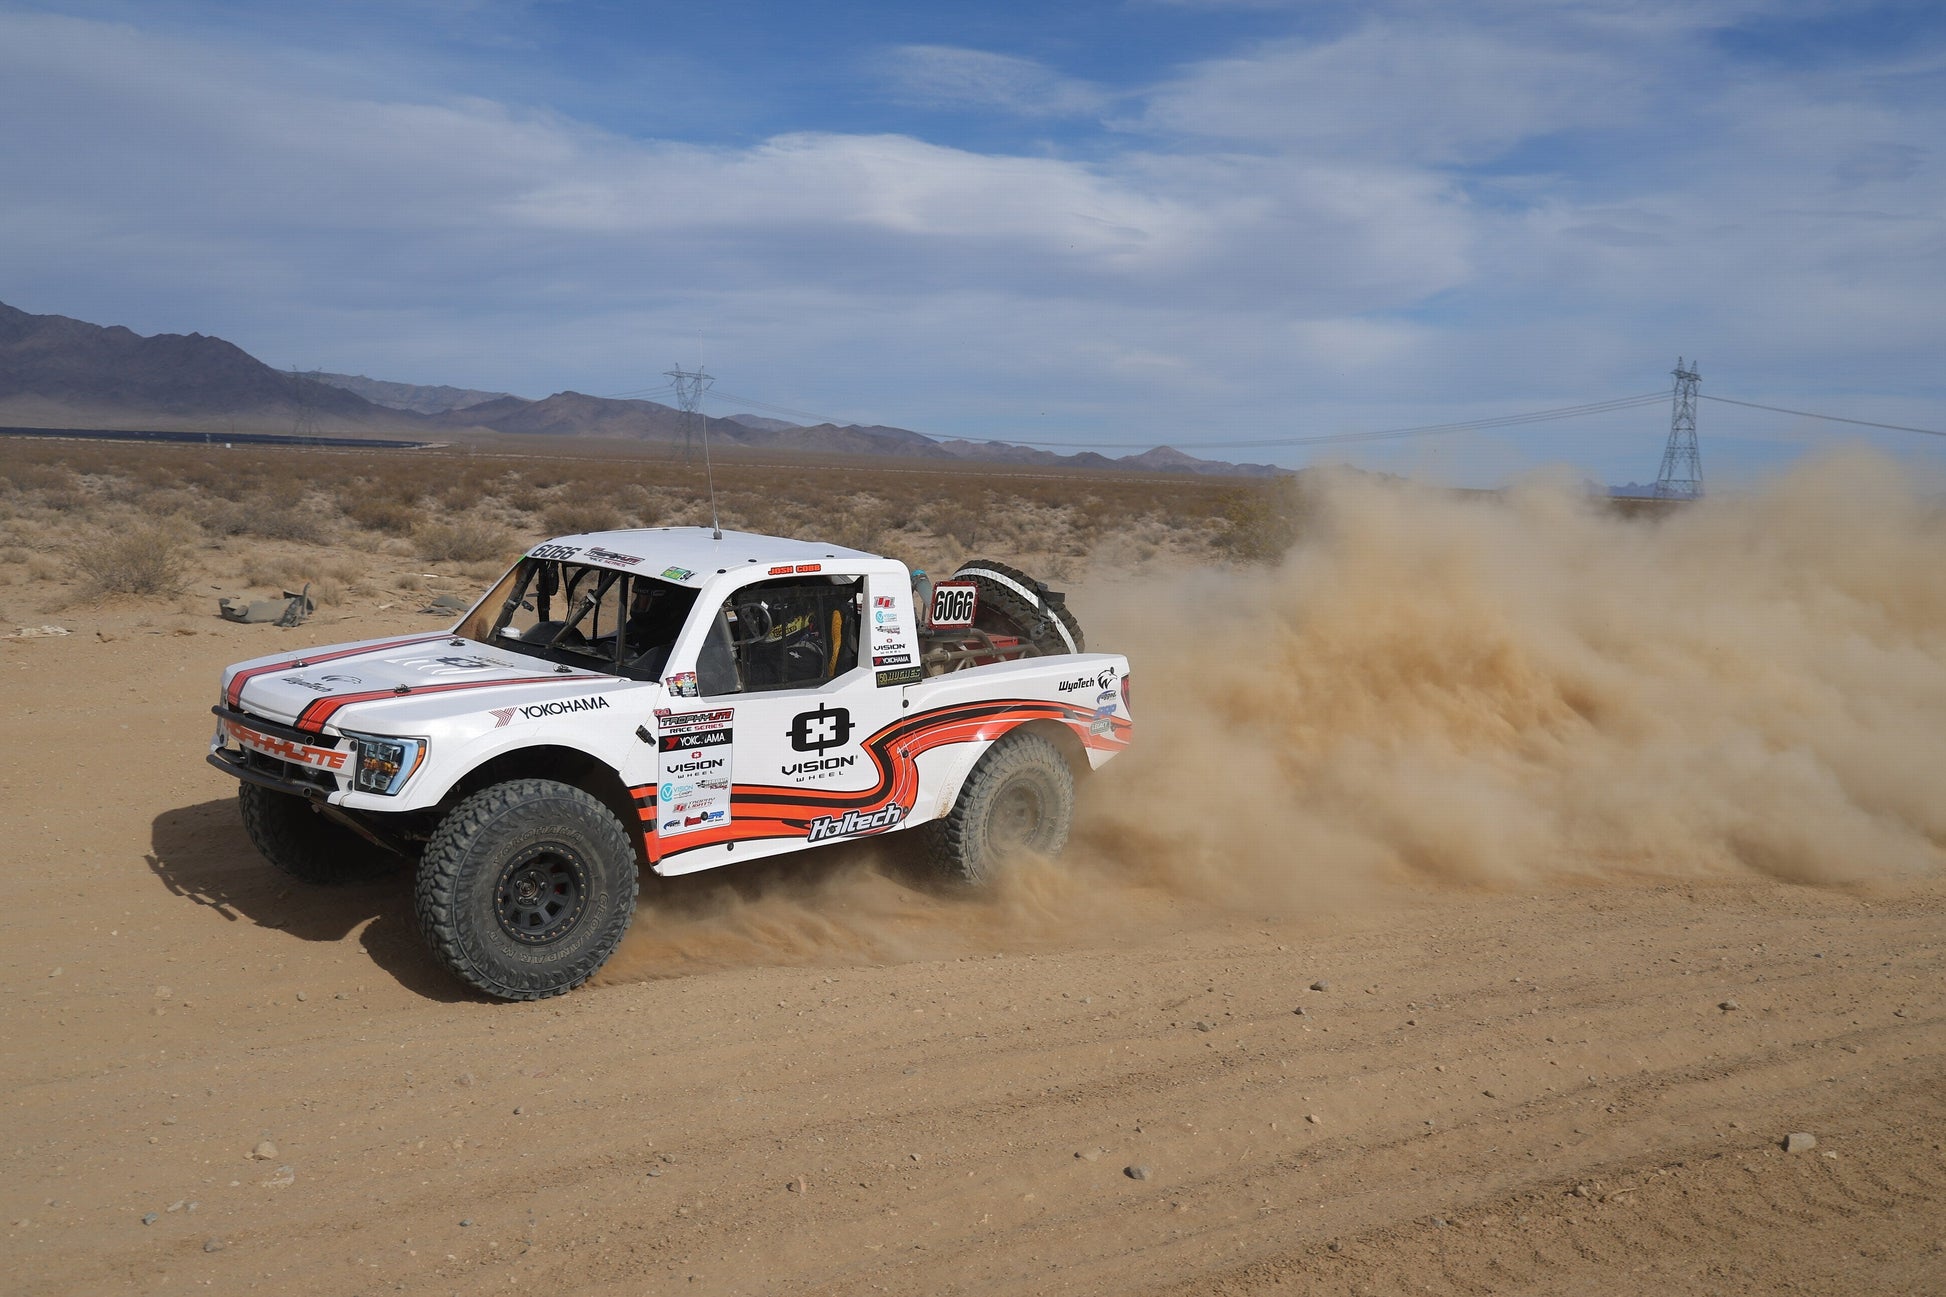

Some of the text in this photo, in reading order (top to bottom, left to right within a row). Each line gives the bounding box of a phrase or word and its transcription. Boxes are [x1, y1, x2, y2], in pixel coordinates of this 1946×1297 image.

[531, 544, 583, 560] 6066
[768, 564, 821, 575] JOSH COBB
[933, 590, 973, 621] 6066
[874, 643, 905, 651] VISION
[882, 655, 910, 664] YOKOHAMA
[1058, 677, 1095, 692] WyoTech
[519, 696, 610, 719] YOKOHAMA
[669, 723, 724, 734] RACE SERIES
[667, 759, 723, 774] VISION
[782, 755, 854, 776] VISION
[677, 770, 714, 779] WHEEL
[796, 771, 844, 782] WHEEL
[673, 785, 694, 793] VISION
[808, 803, 901, 842] Haltech
